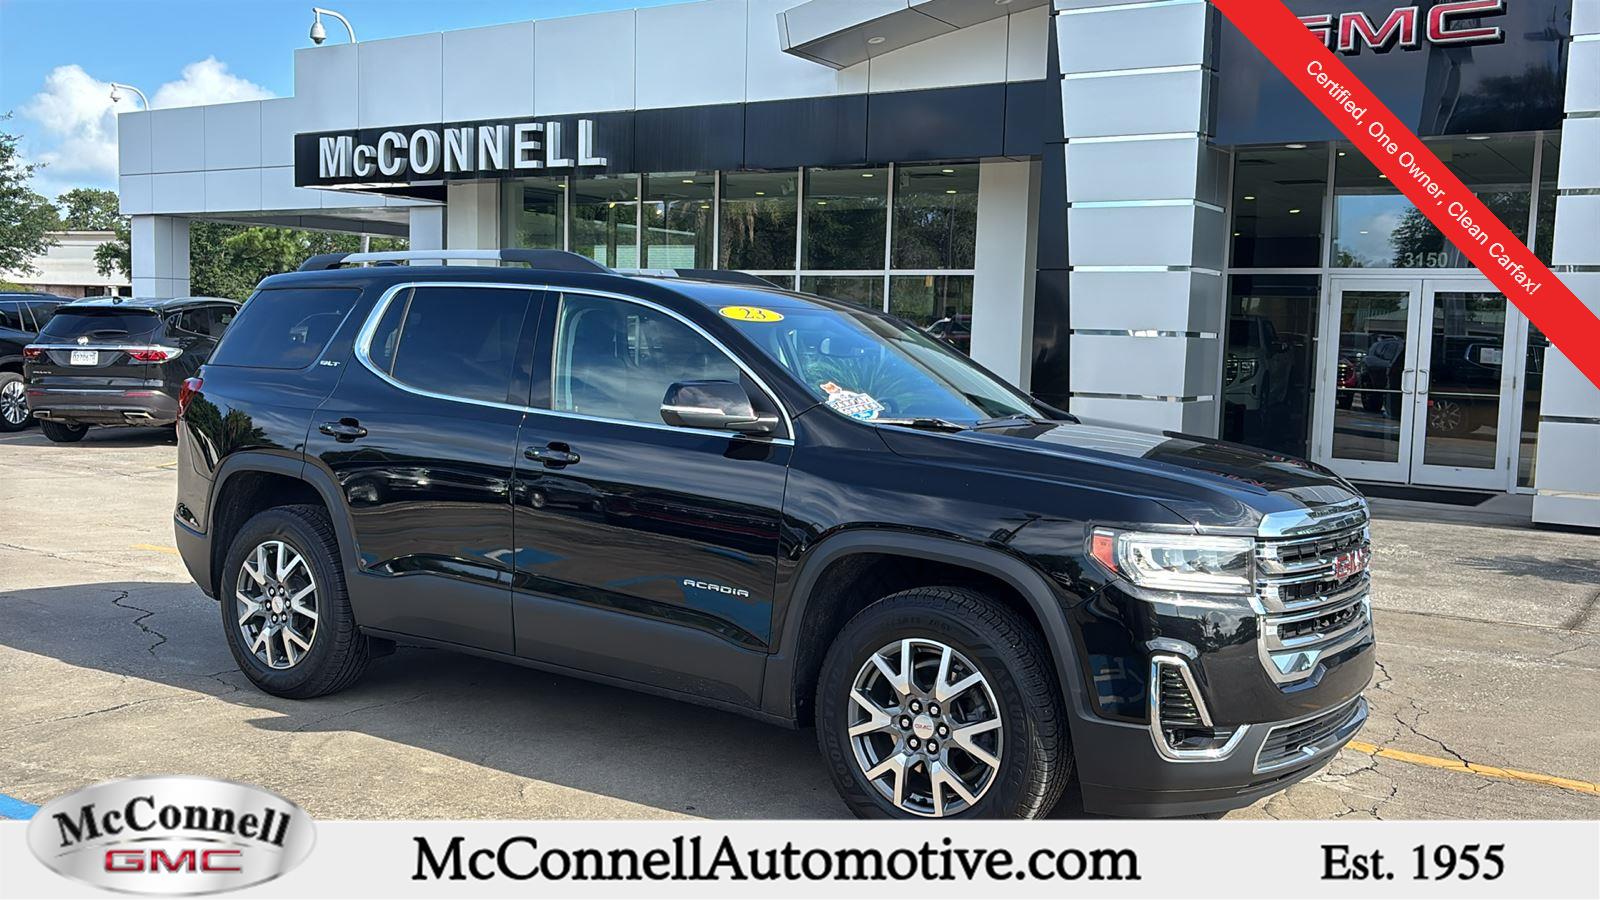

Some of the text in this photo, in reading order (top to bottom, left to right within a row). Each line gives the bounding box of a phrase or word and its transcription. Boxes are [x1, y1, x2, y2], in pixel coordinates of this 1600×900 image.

[1403, 251, 1448, 268] 3150
[738, 307, 767, 320] 23
[683, 578, 749, 598] ACADIA
